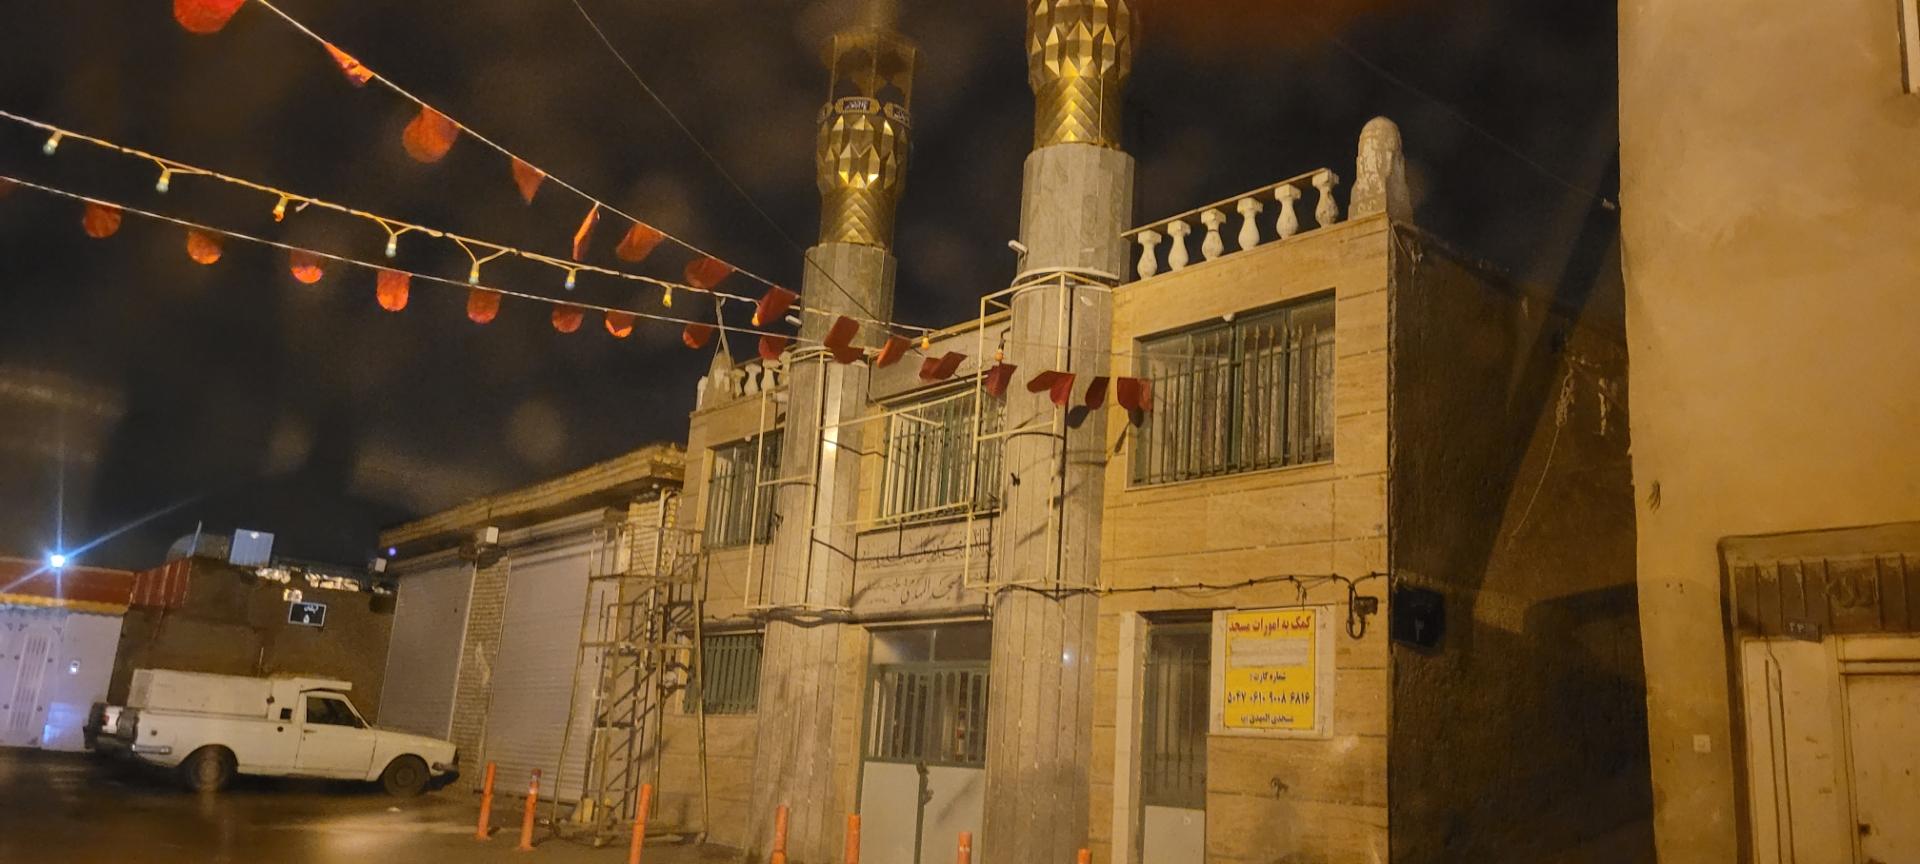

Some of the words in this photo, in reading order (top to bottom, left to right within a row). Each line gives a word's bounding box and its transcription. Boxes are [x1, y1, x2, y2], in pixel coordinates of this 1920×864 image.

[1229, 622, 1250, 632] مسجد
[1253, 617, 1280, 636] امورات
[1282, 620, 1289, 633] به
[1291, 616, 1311, 630] کمک
[1270, 671, 1286, 684] شماره
[1250, 691, 1265, 704] ۰۶۱۰
[1269, 690, 1286, 704] ۹۰۰۸
[1290, 690, 1310, 704] ۶۸۱۶
